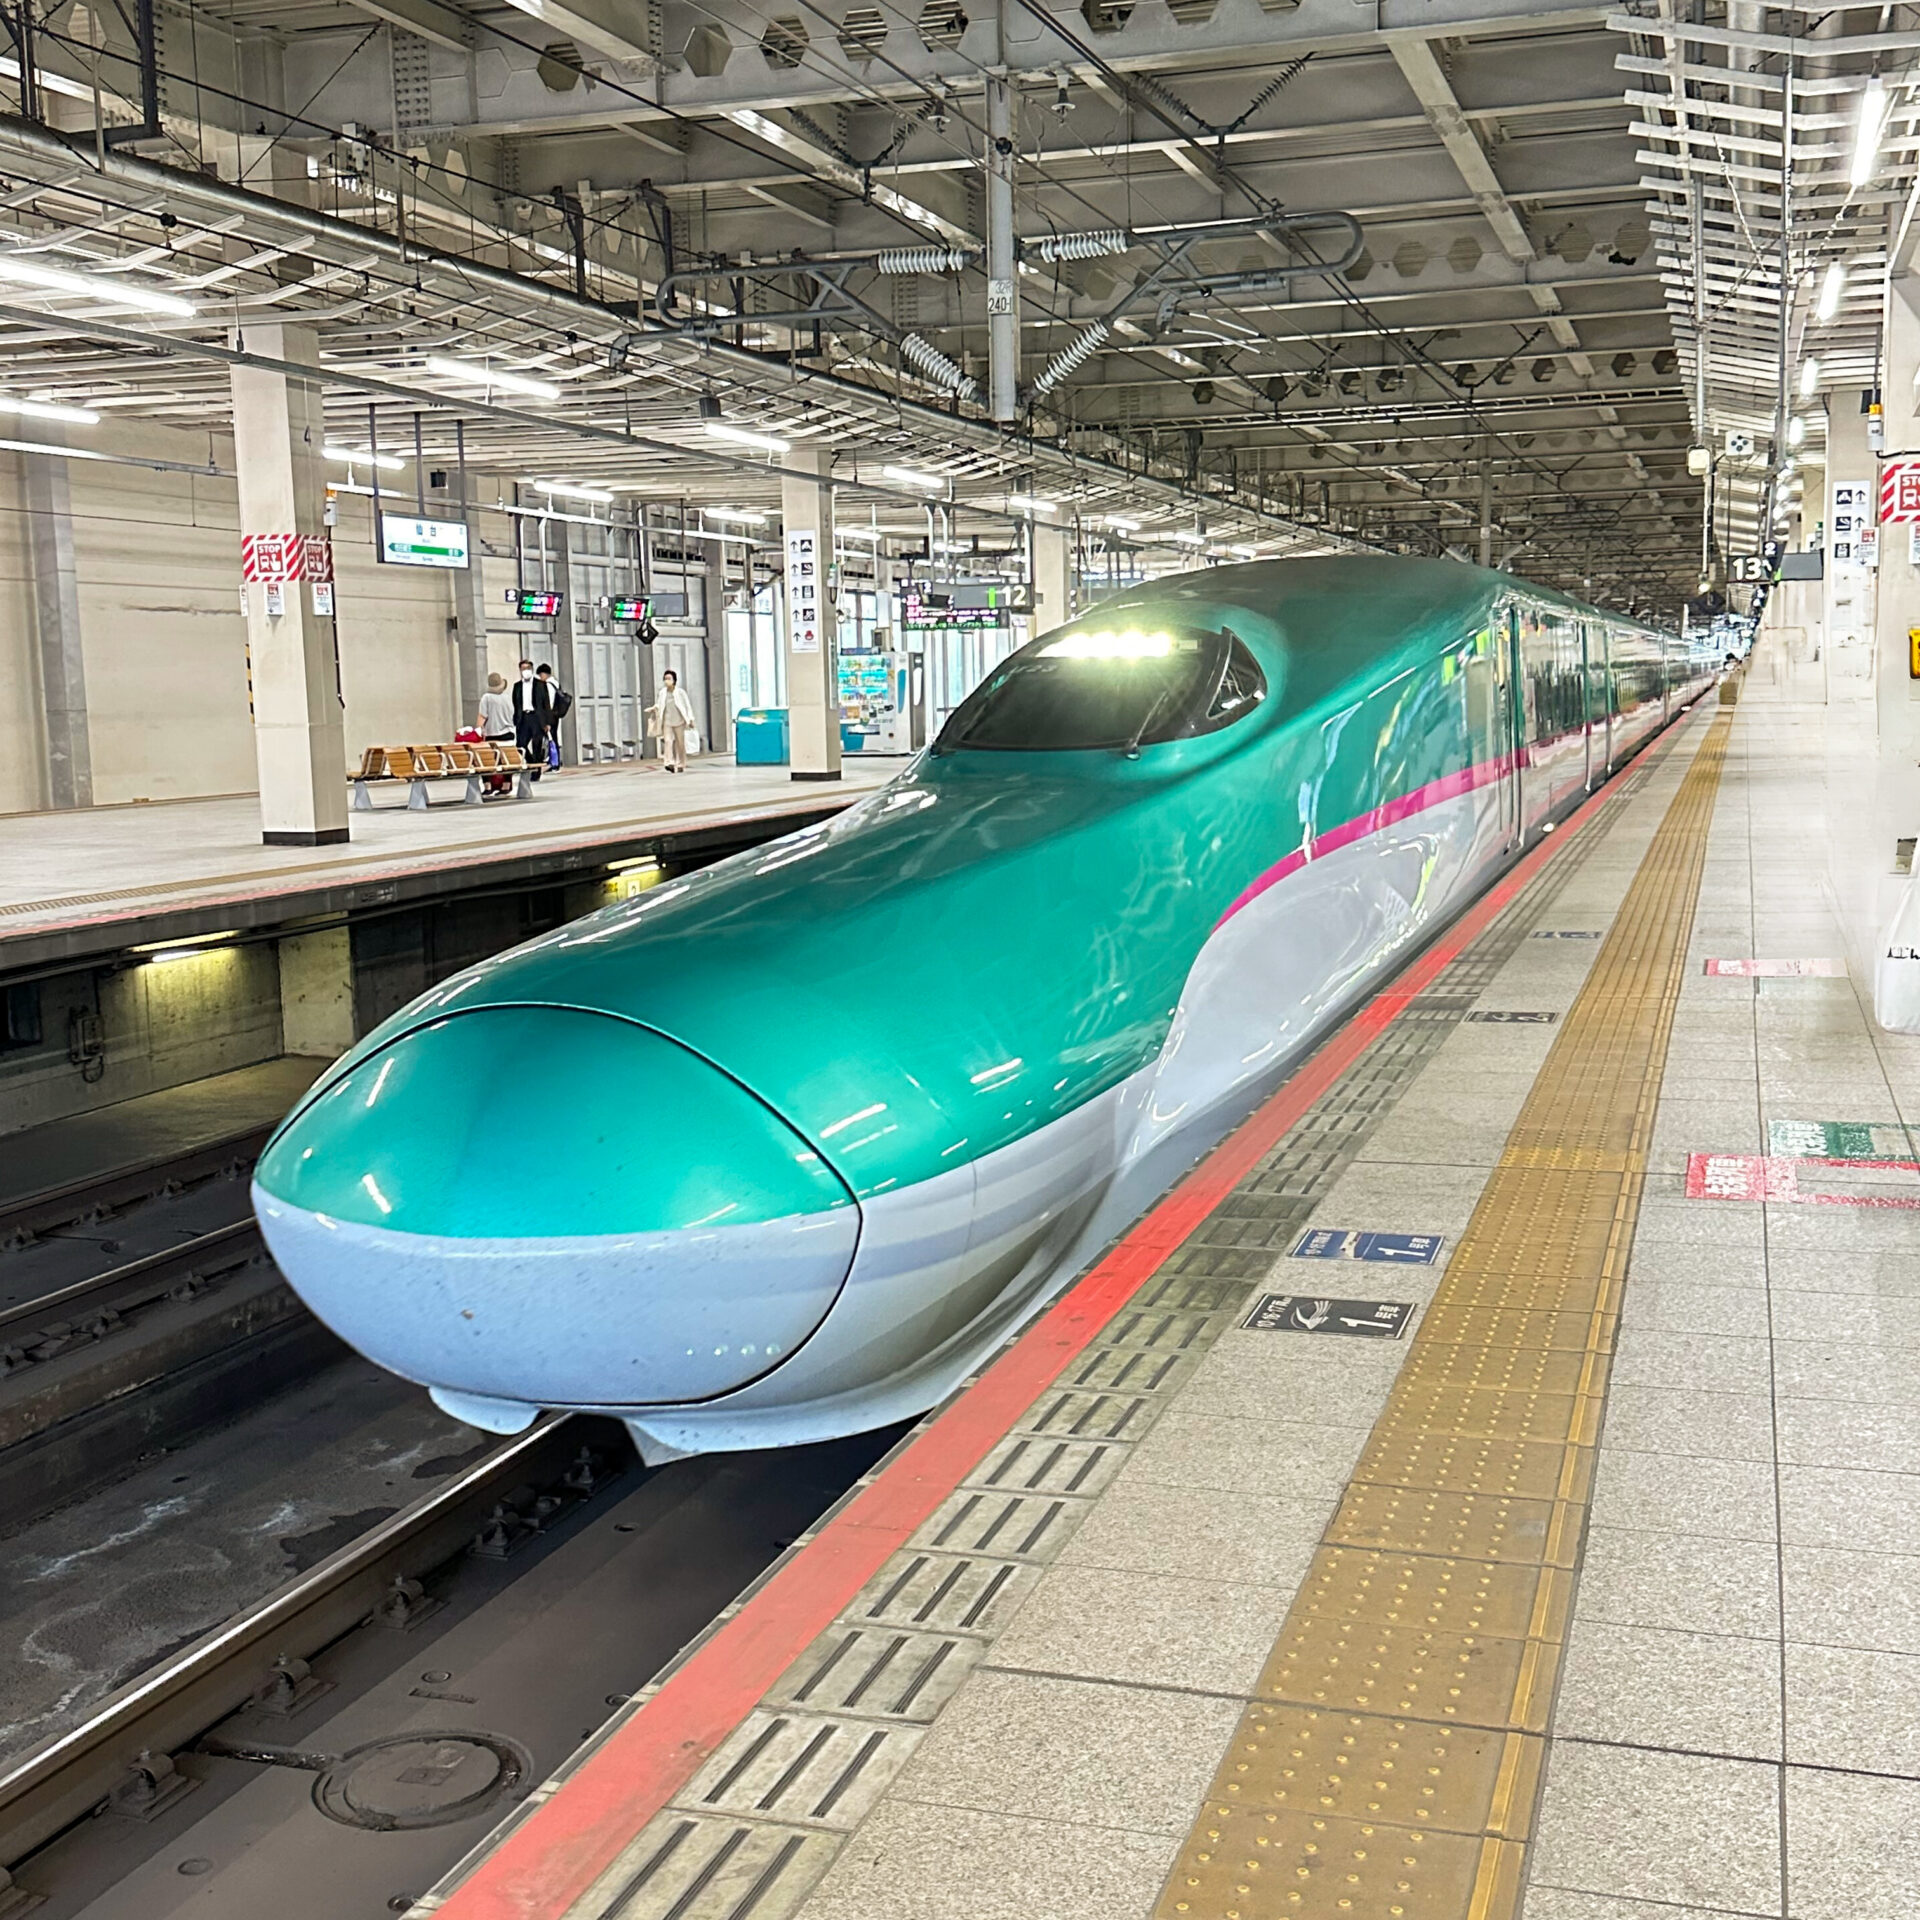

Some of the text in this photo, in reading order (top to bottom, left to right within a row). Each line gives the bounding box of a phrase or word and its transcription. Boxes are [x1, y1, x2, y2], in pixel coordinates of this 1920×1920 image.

[258, 545, 281, 554] STOP
[307, 545, 322, 553] STOP
[1764, 542, 1776, 556] 2
[1732, 557, 1761, 580] 13
[506, 589, 516, 601] 2
[1002, 585, 1026, 606] 12
